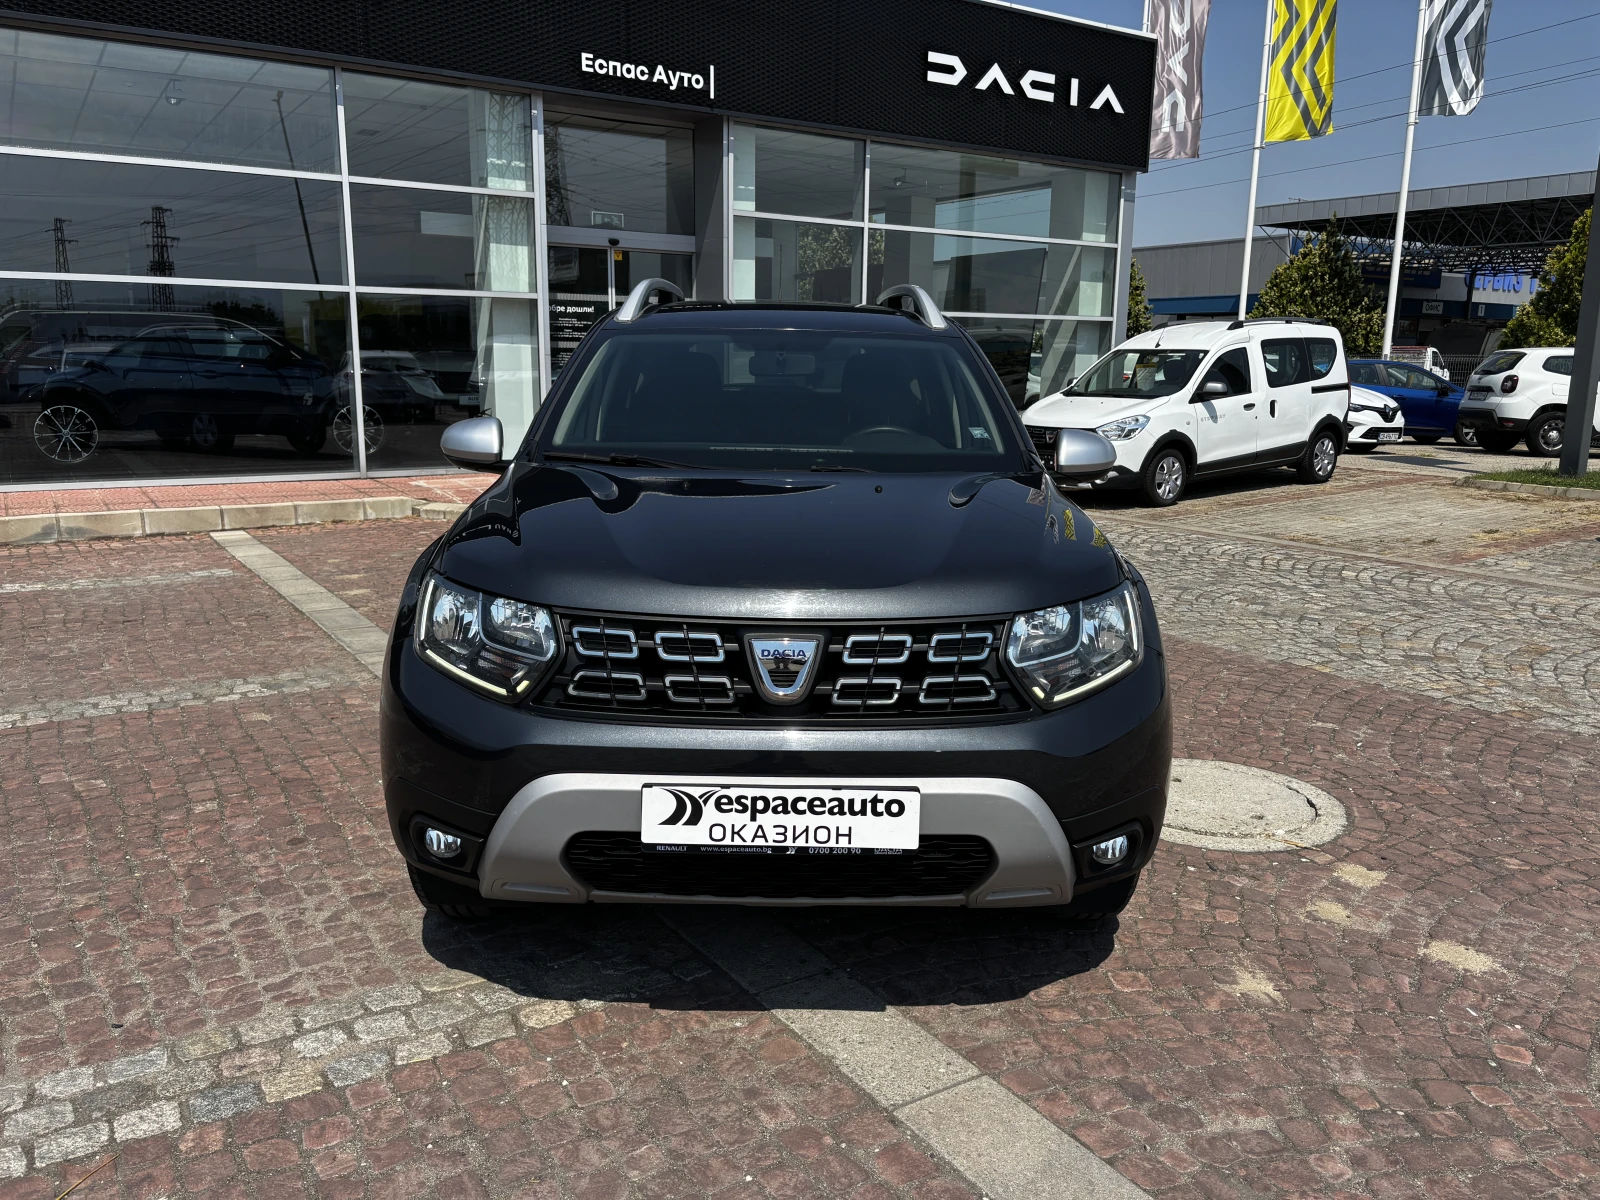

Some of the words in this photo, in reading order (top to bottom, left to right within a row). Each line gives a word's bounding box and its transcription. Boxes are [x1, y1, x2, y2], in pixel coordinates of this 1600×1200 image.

[581, 52, 649, 82] Еспас
[652, 63, 705, 91] Ауто
[926, 50, 1125, 114] DACIA
[566, 305, 595, 313] дошли!
[1425, 303, 1440, 312] ОФИС
[761, 649, 807, 659] DACIA
[713, 793, 906, 822] espaceauto
[708, 823, 853, 846] ОКАЗИОН
[850, 847, 862, 855] 90
